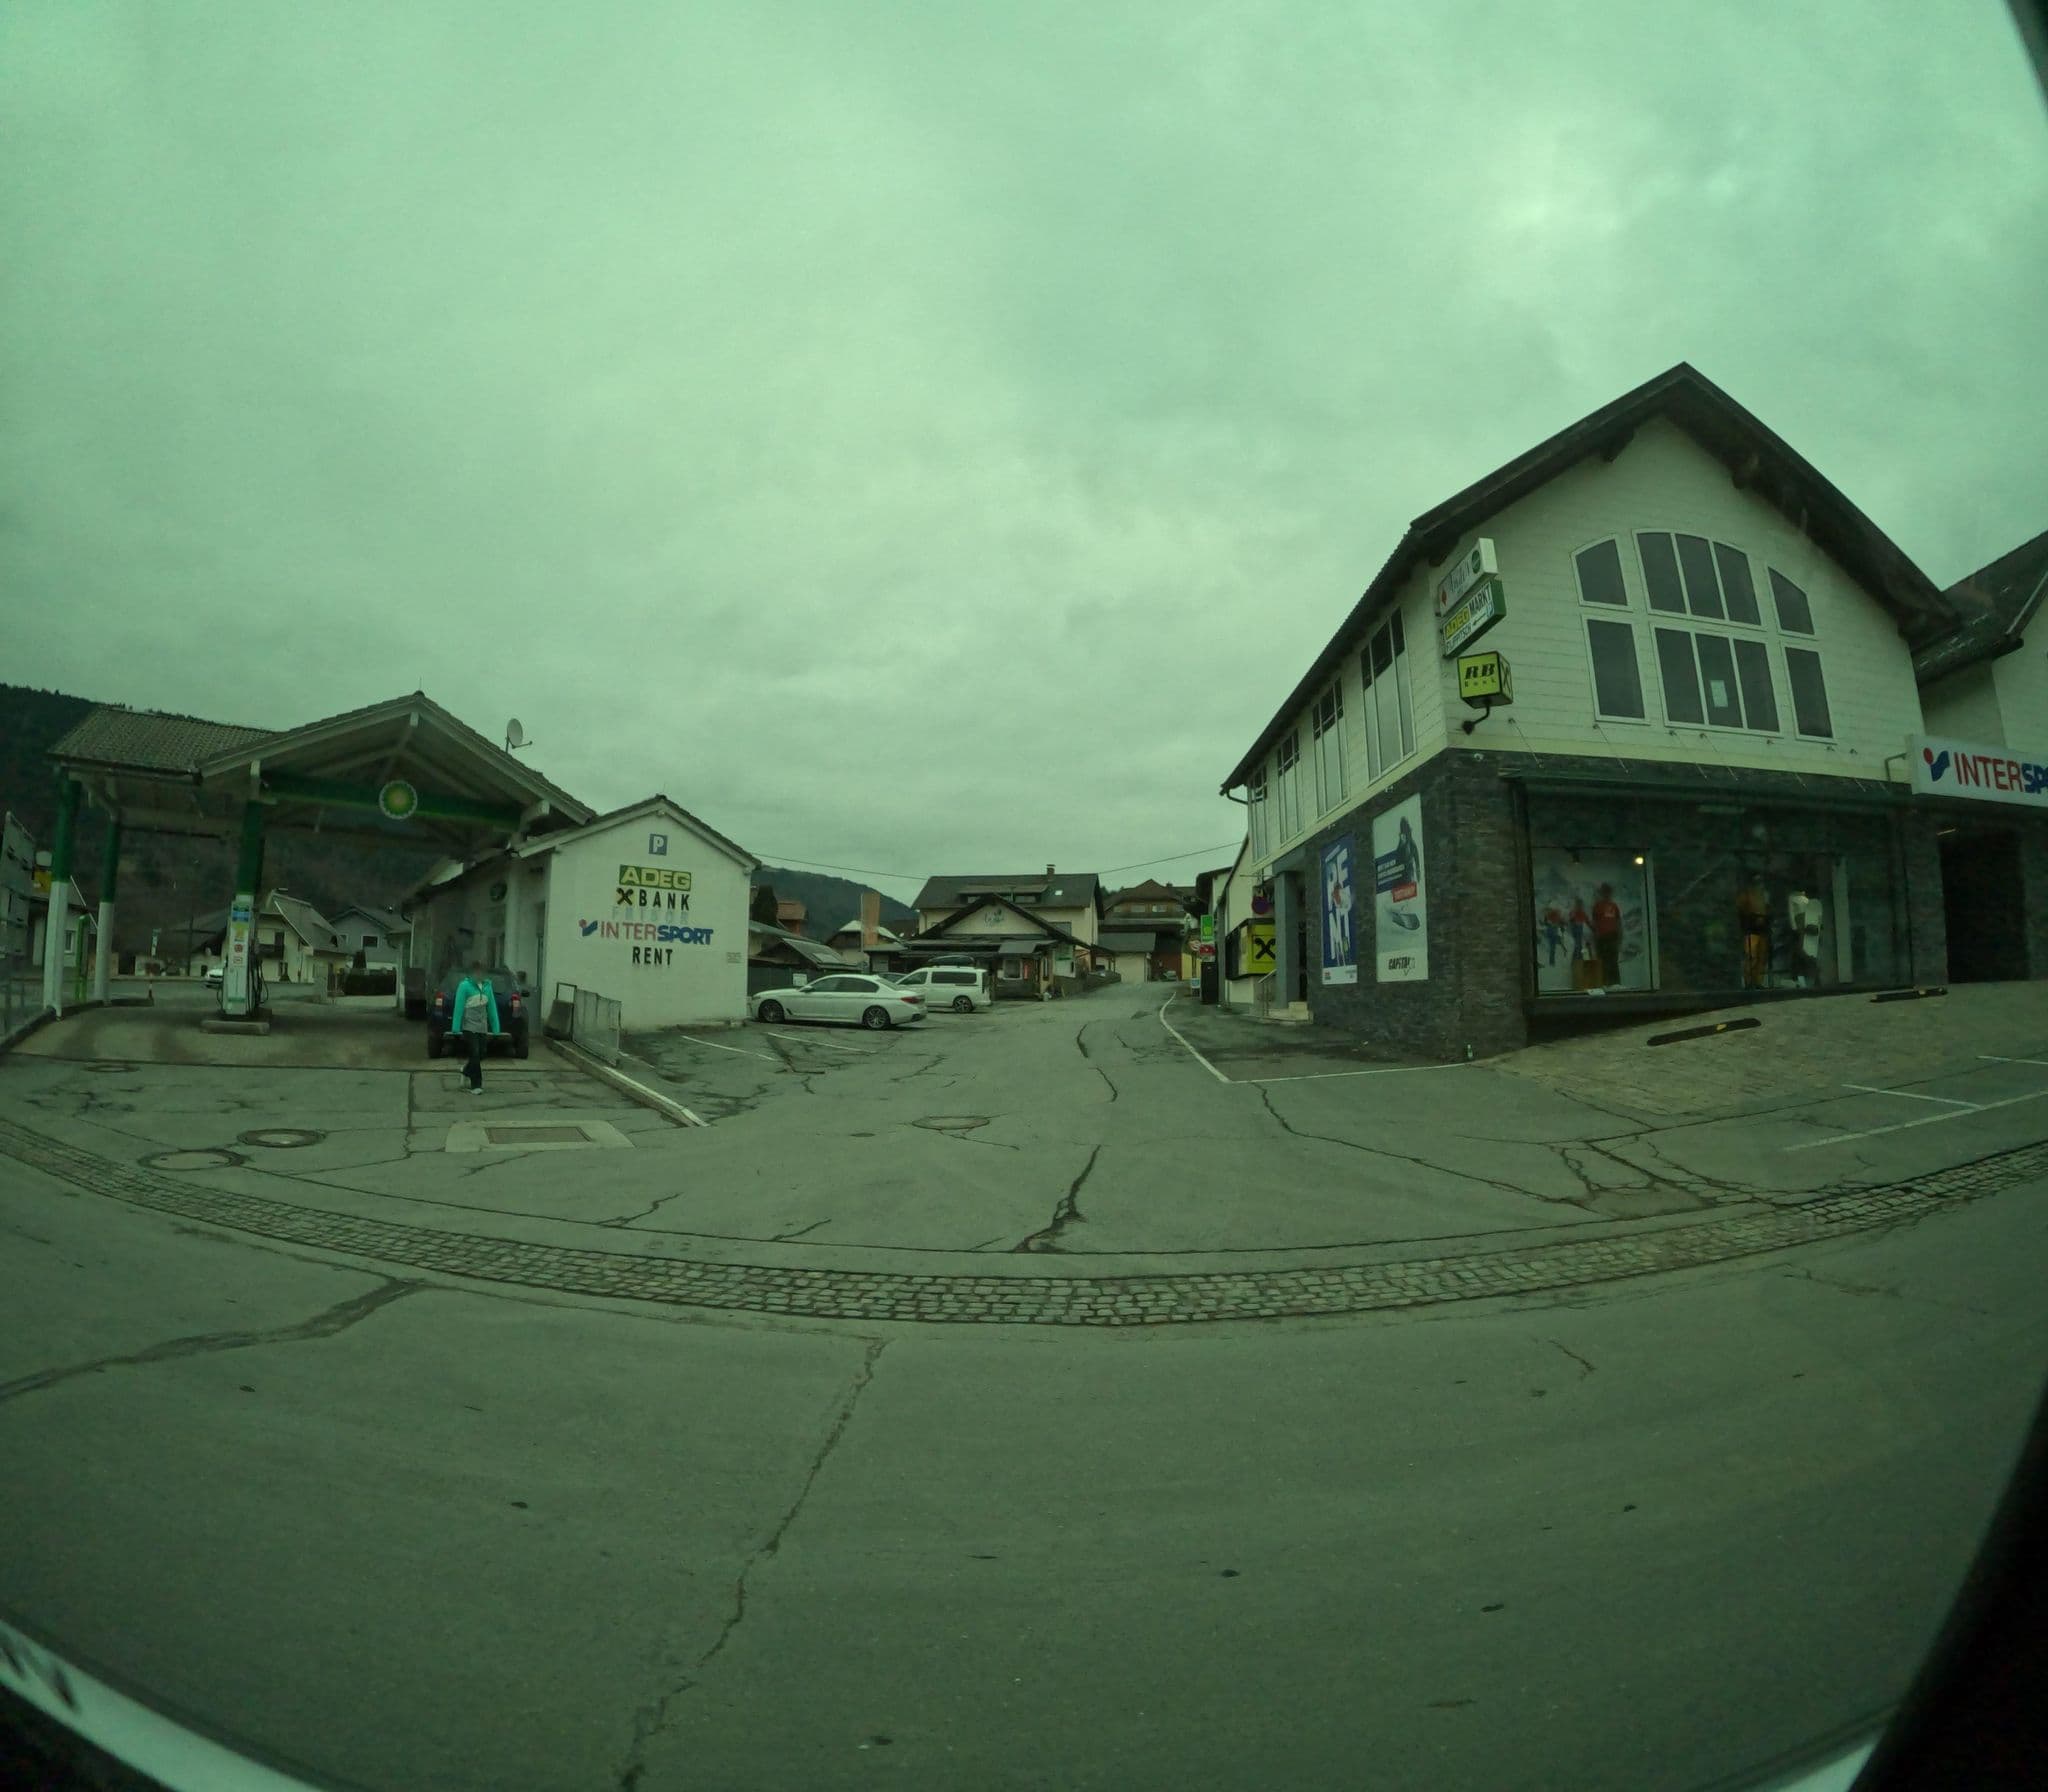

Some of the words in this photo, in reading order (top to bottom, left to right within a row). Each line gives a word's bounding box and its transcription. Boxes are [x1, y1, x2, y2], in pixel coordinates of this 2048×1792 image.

[621, 866, 691, 890] ADEG
[639, 889, 690, 911] BANK
[600, 920, 714, 945] INTERSPORT
[632, 946, 674, 966] RENT
